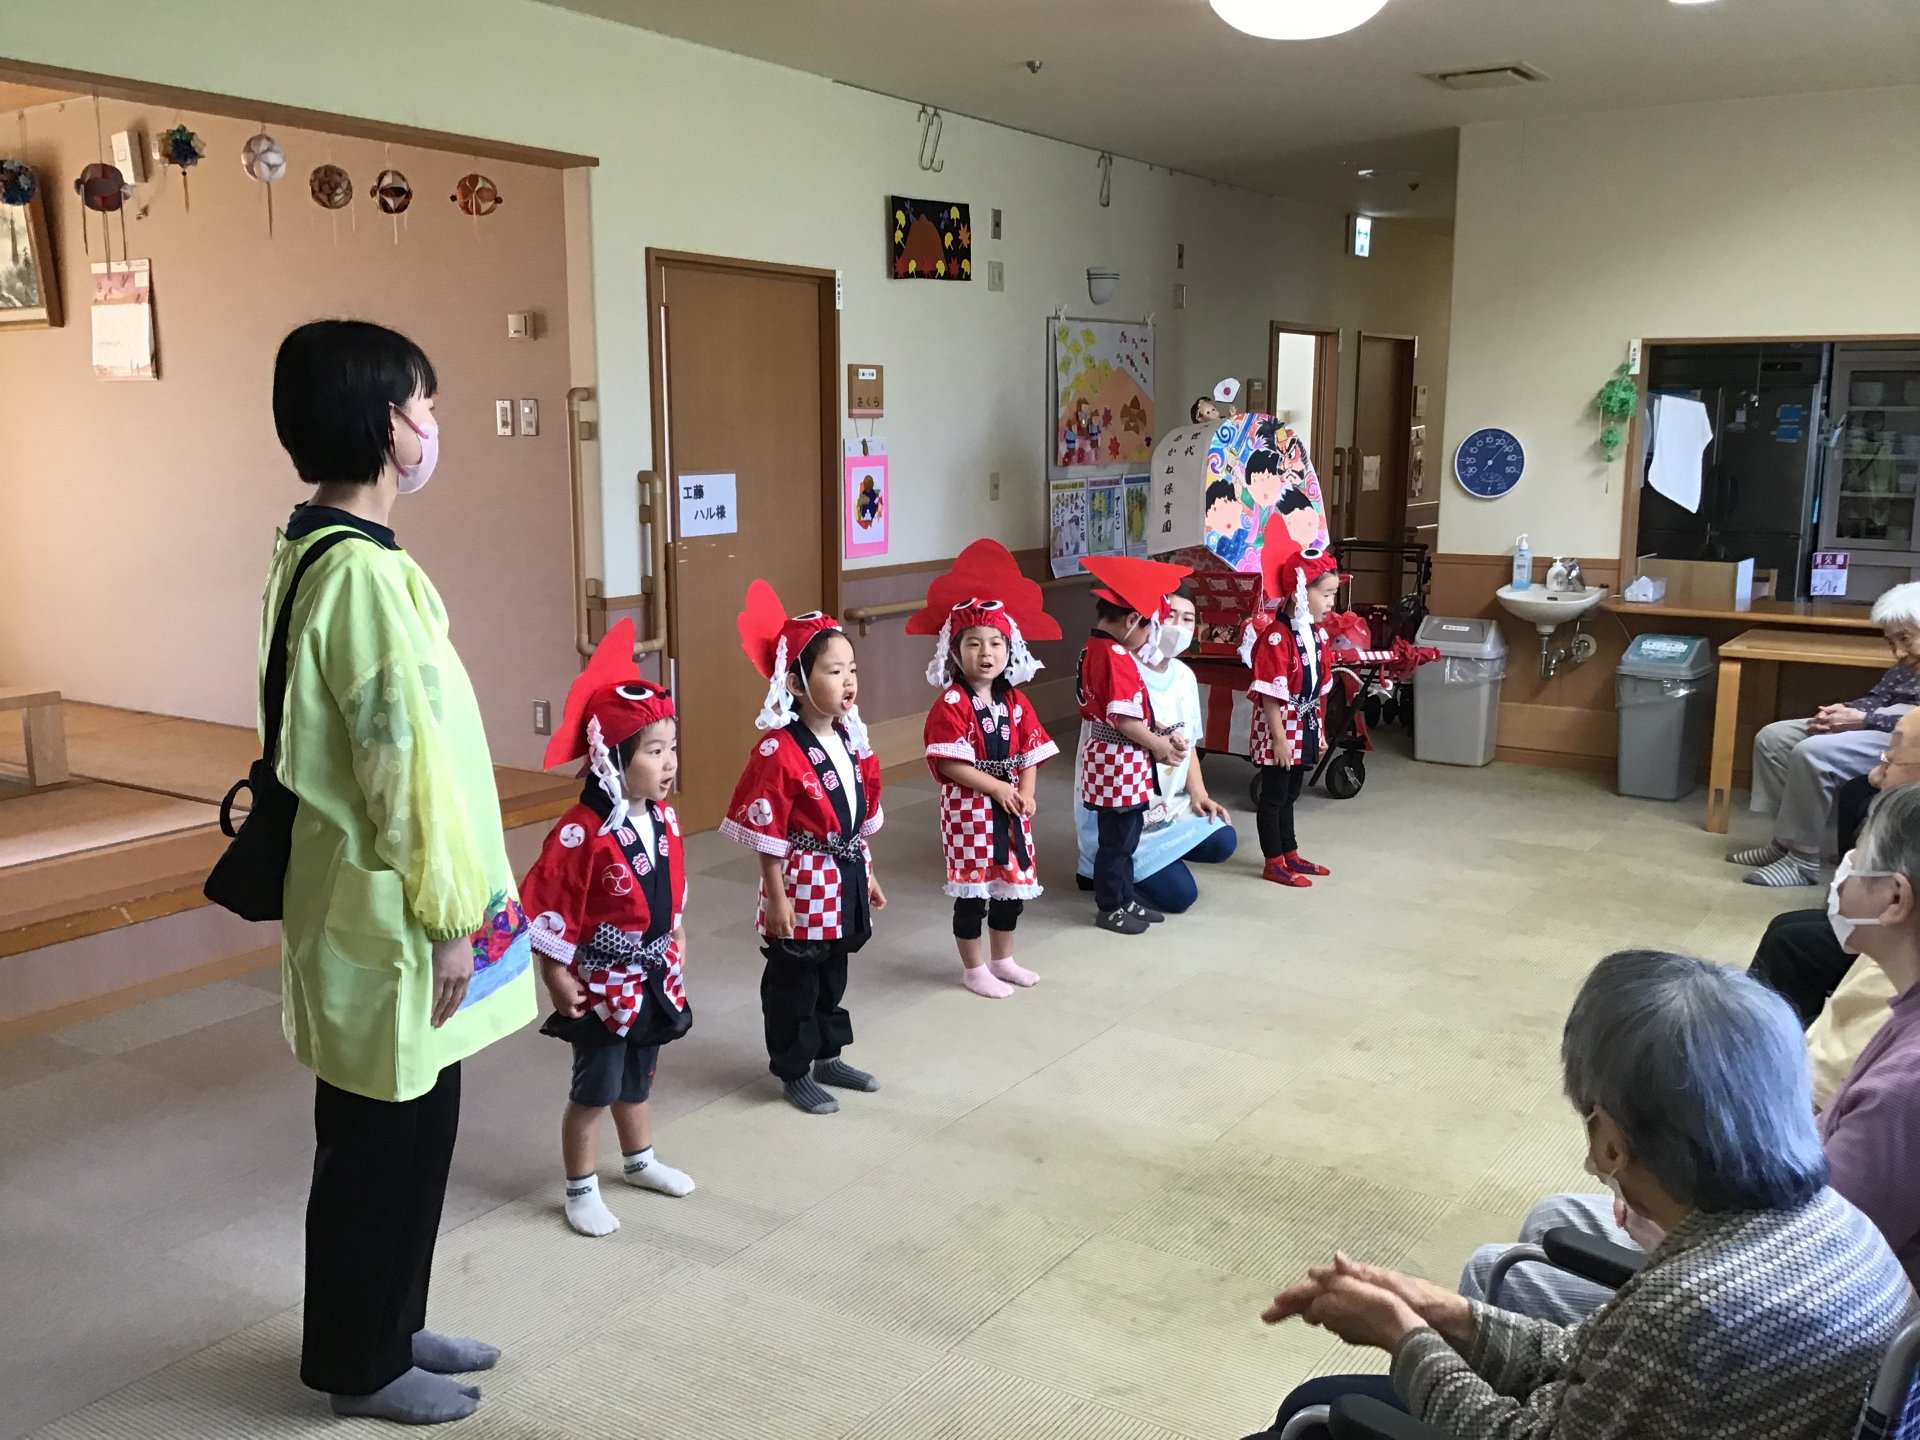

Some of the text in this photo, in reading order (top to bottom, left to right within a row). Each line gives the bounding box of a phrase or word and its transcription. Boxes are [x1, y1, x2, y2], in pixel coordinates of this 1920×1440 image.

[857, 396, 880, 408] さくら
[683, 484, 704, 500] 工藤
[694, 504, 726, 520] ハル様
